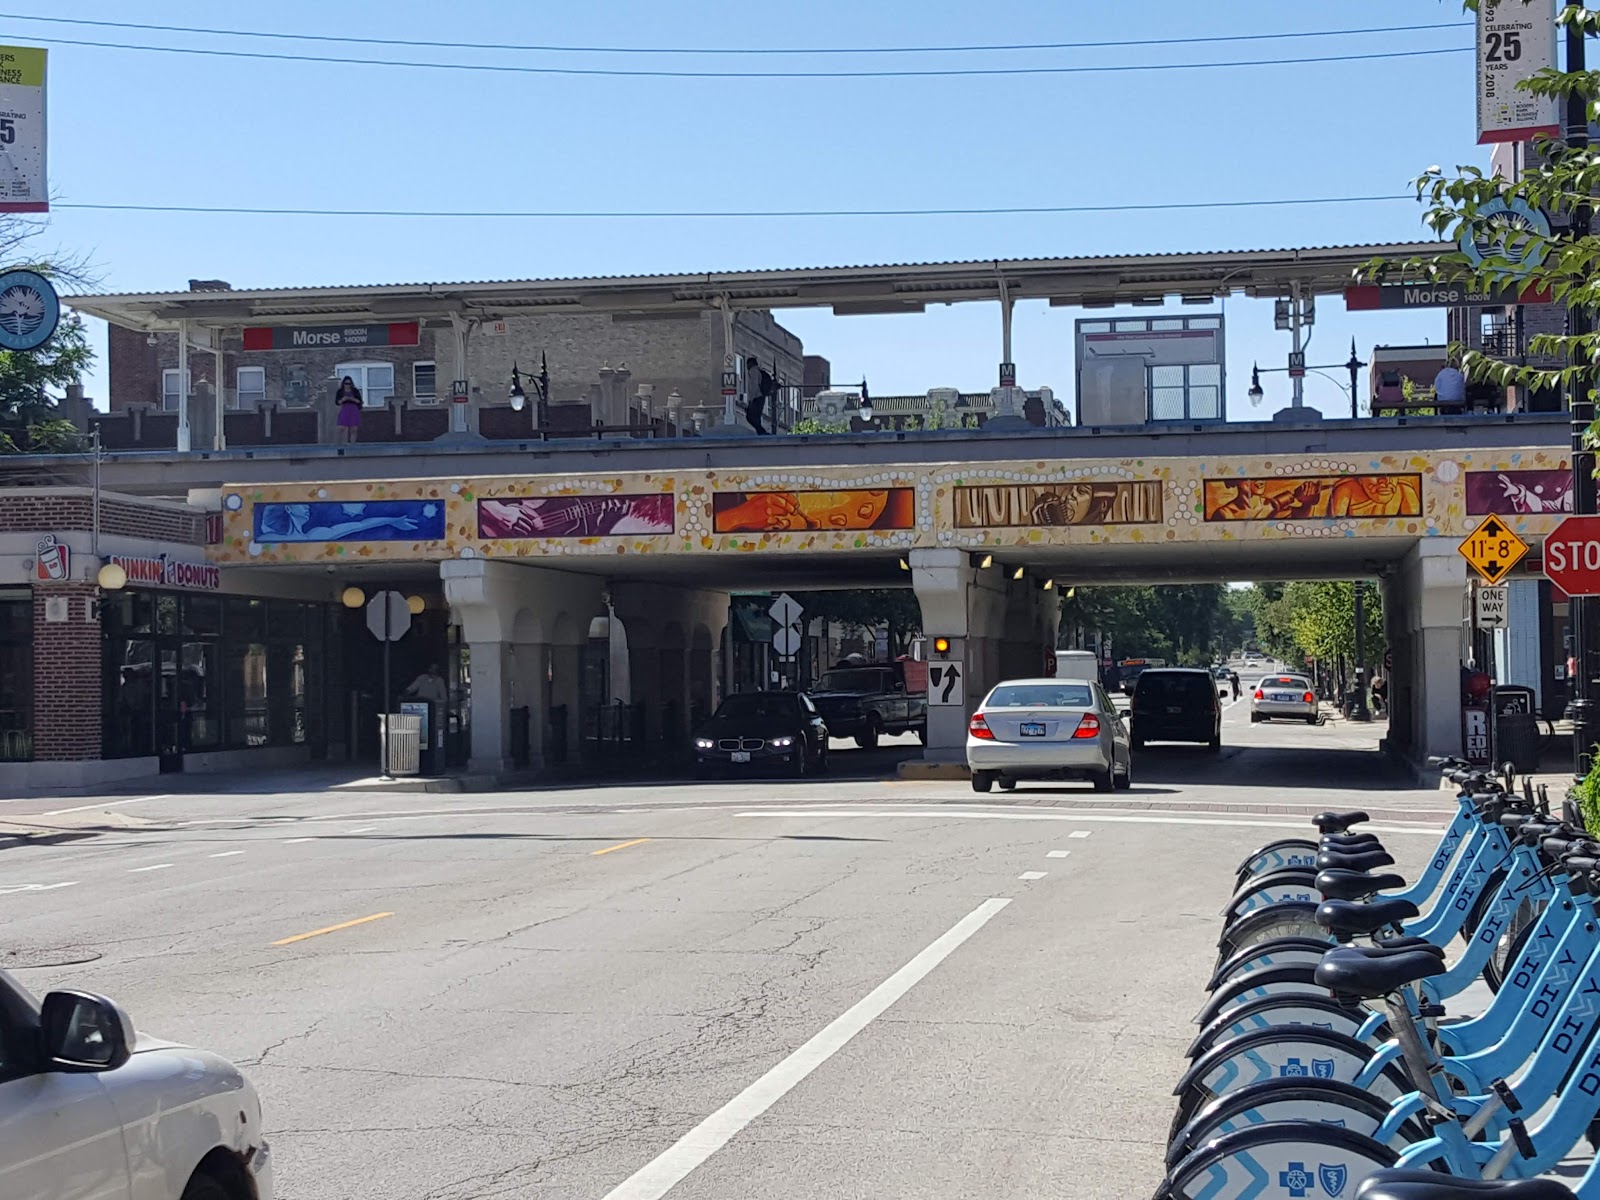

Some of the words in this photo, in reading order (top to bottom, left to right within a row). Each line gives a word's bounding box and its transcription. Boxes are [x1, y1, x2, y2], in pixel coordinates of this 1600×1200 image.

[1485, 1, 1494, 22] 993
[1485, 23, 1533, 31] CELEBRATING
[1485, 31, 1521, 62] 25
[1486, 74, 1495, 98] 2018
[0, 118, 15, 144] 5
[1403, 288, 1459, 304] Morse
[1464, 293, 1491, 301] 1400W
[293, 330, 341, 345] Morse
[1291, 354, 1303, 365] M
[1001, 365, 1013, 376] M
[723, 373, 735, 385] M
[455, 381, 466, 393] M
[1549, 540, 1600, 571] STO
[176, 561, 220, 589] DONUTS
[1482, 590, 1503, 601] ONE
[1482, 602, 1503, 612] WAY
[1468, 749, 1487, 758] EYE
